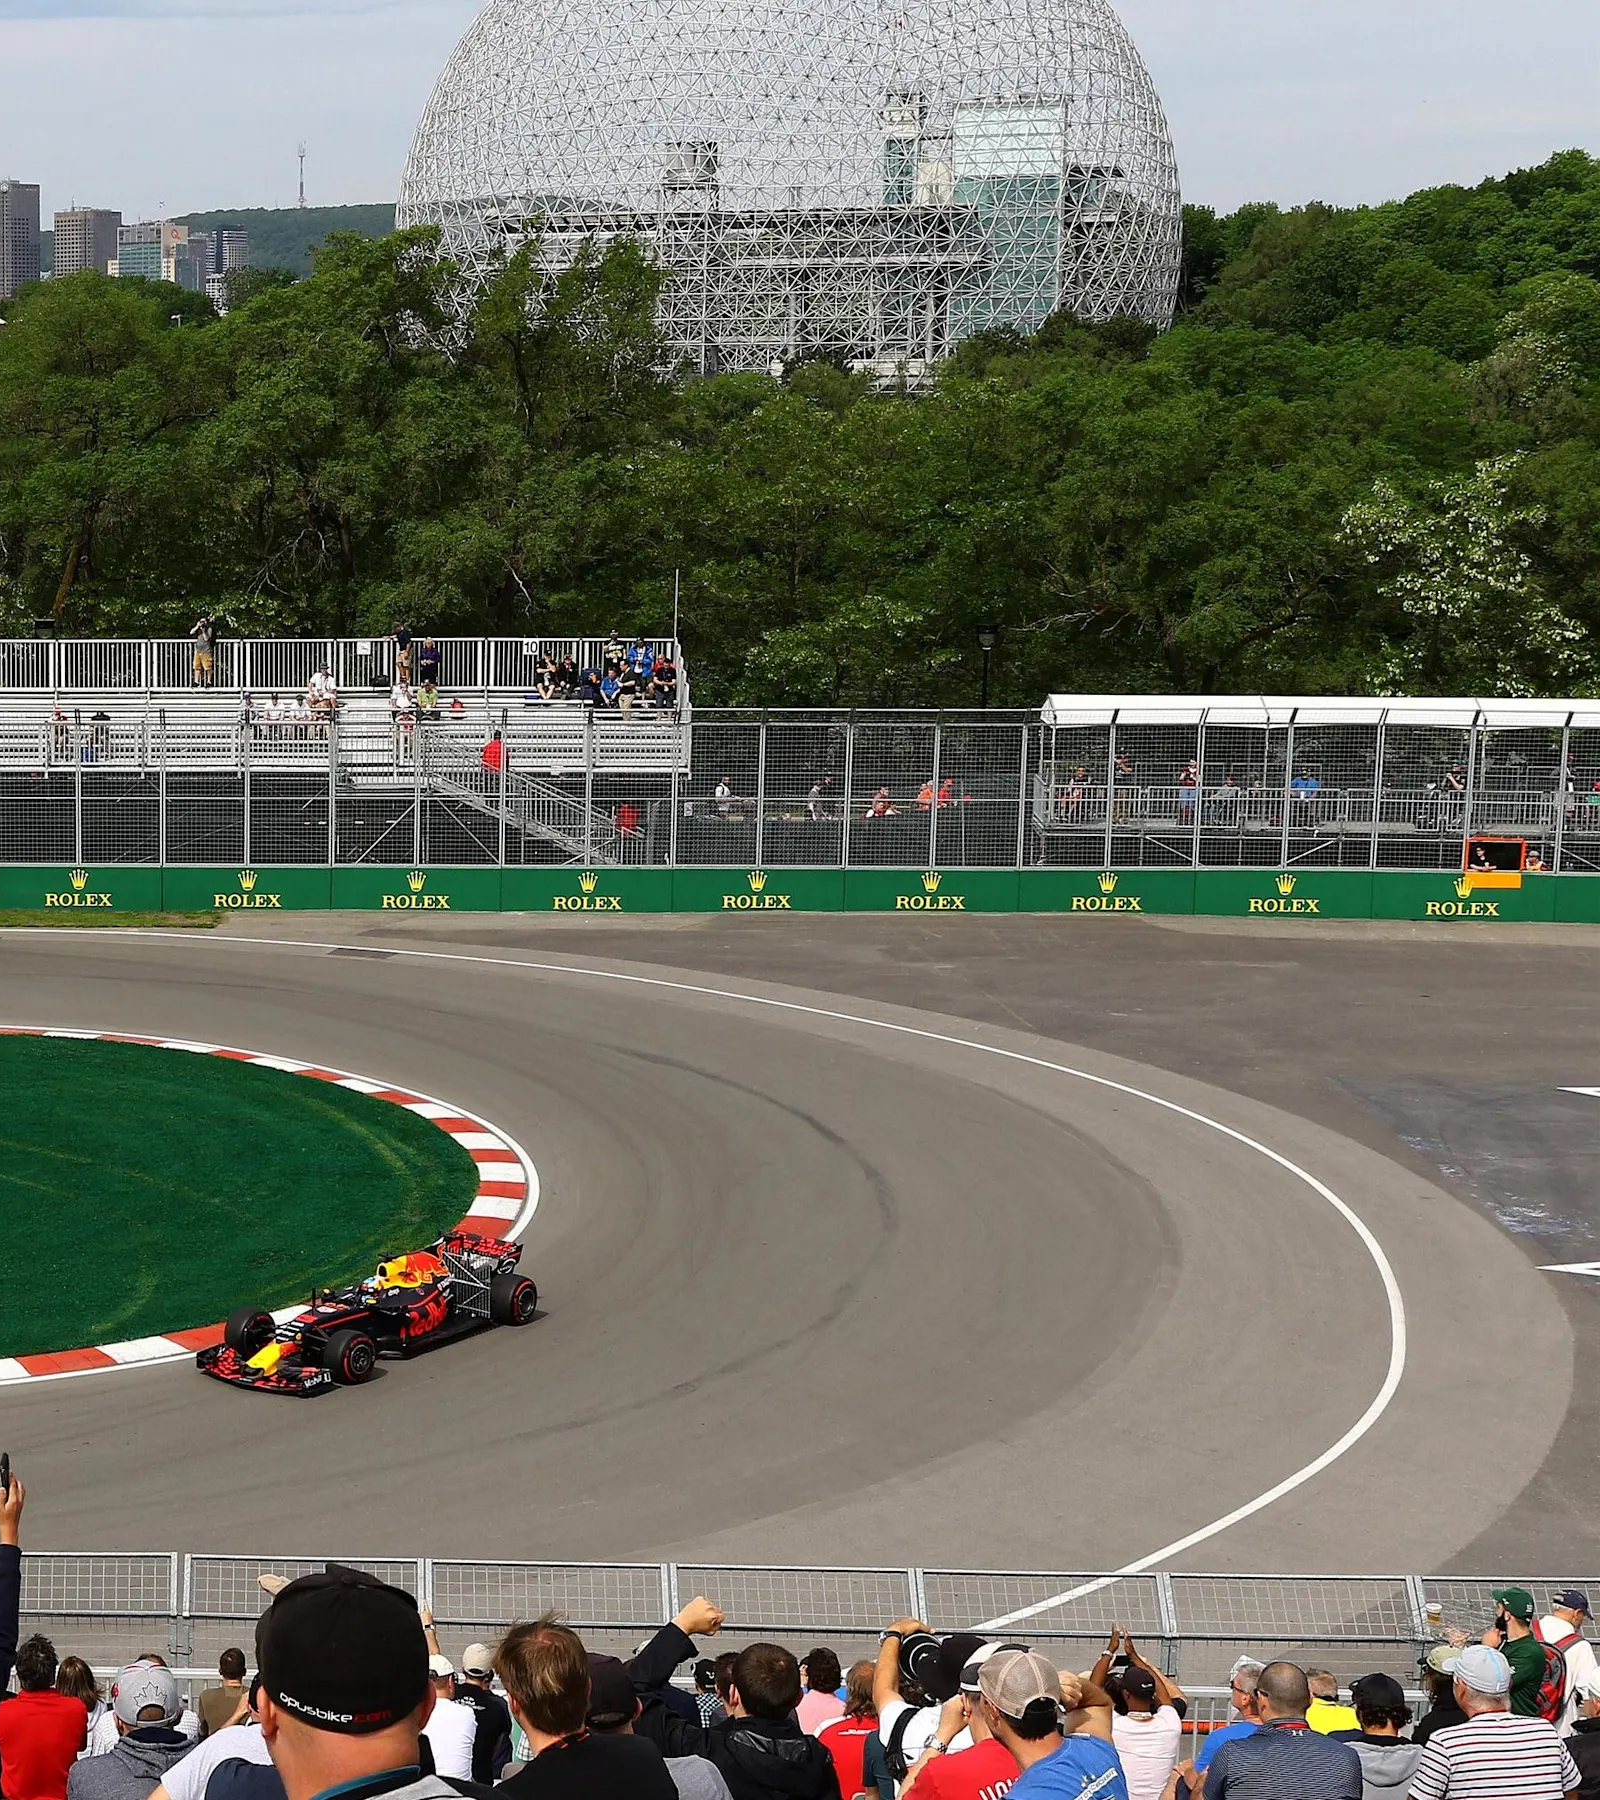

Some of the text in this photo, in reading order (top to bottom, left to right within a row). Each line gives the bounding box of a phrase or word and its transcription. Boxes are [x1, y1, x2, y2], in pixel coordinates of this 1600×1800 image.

[524, 640, 538, 653] 10
[45, 893, 112, 906] ROLEX
[214, 894, 281, 907] ROLEX
[382, 895, 450, 908] ROLEX
[553, 897, 622, 910] ROLEX
[722, 895, 791, 908] ROLEX
[896, 896, 965, 909] ROLEX
[1072, 897, 1141, 910] ROLEX
[1248, 899, 1320, 912] ROLEX
[1426, 902, 1499, 916] ROLEX
